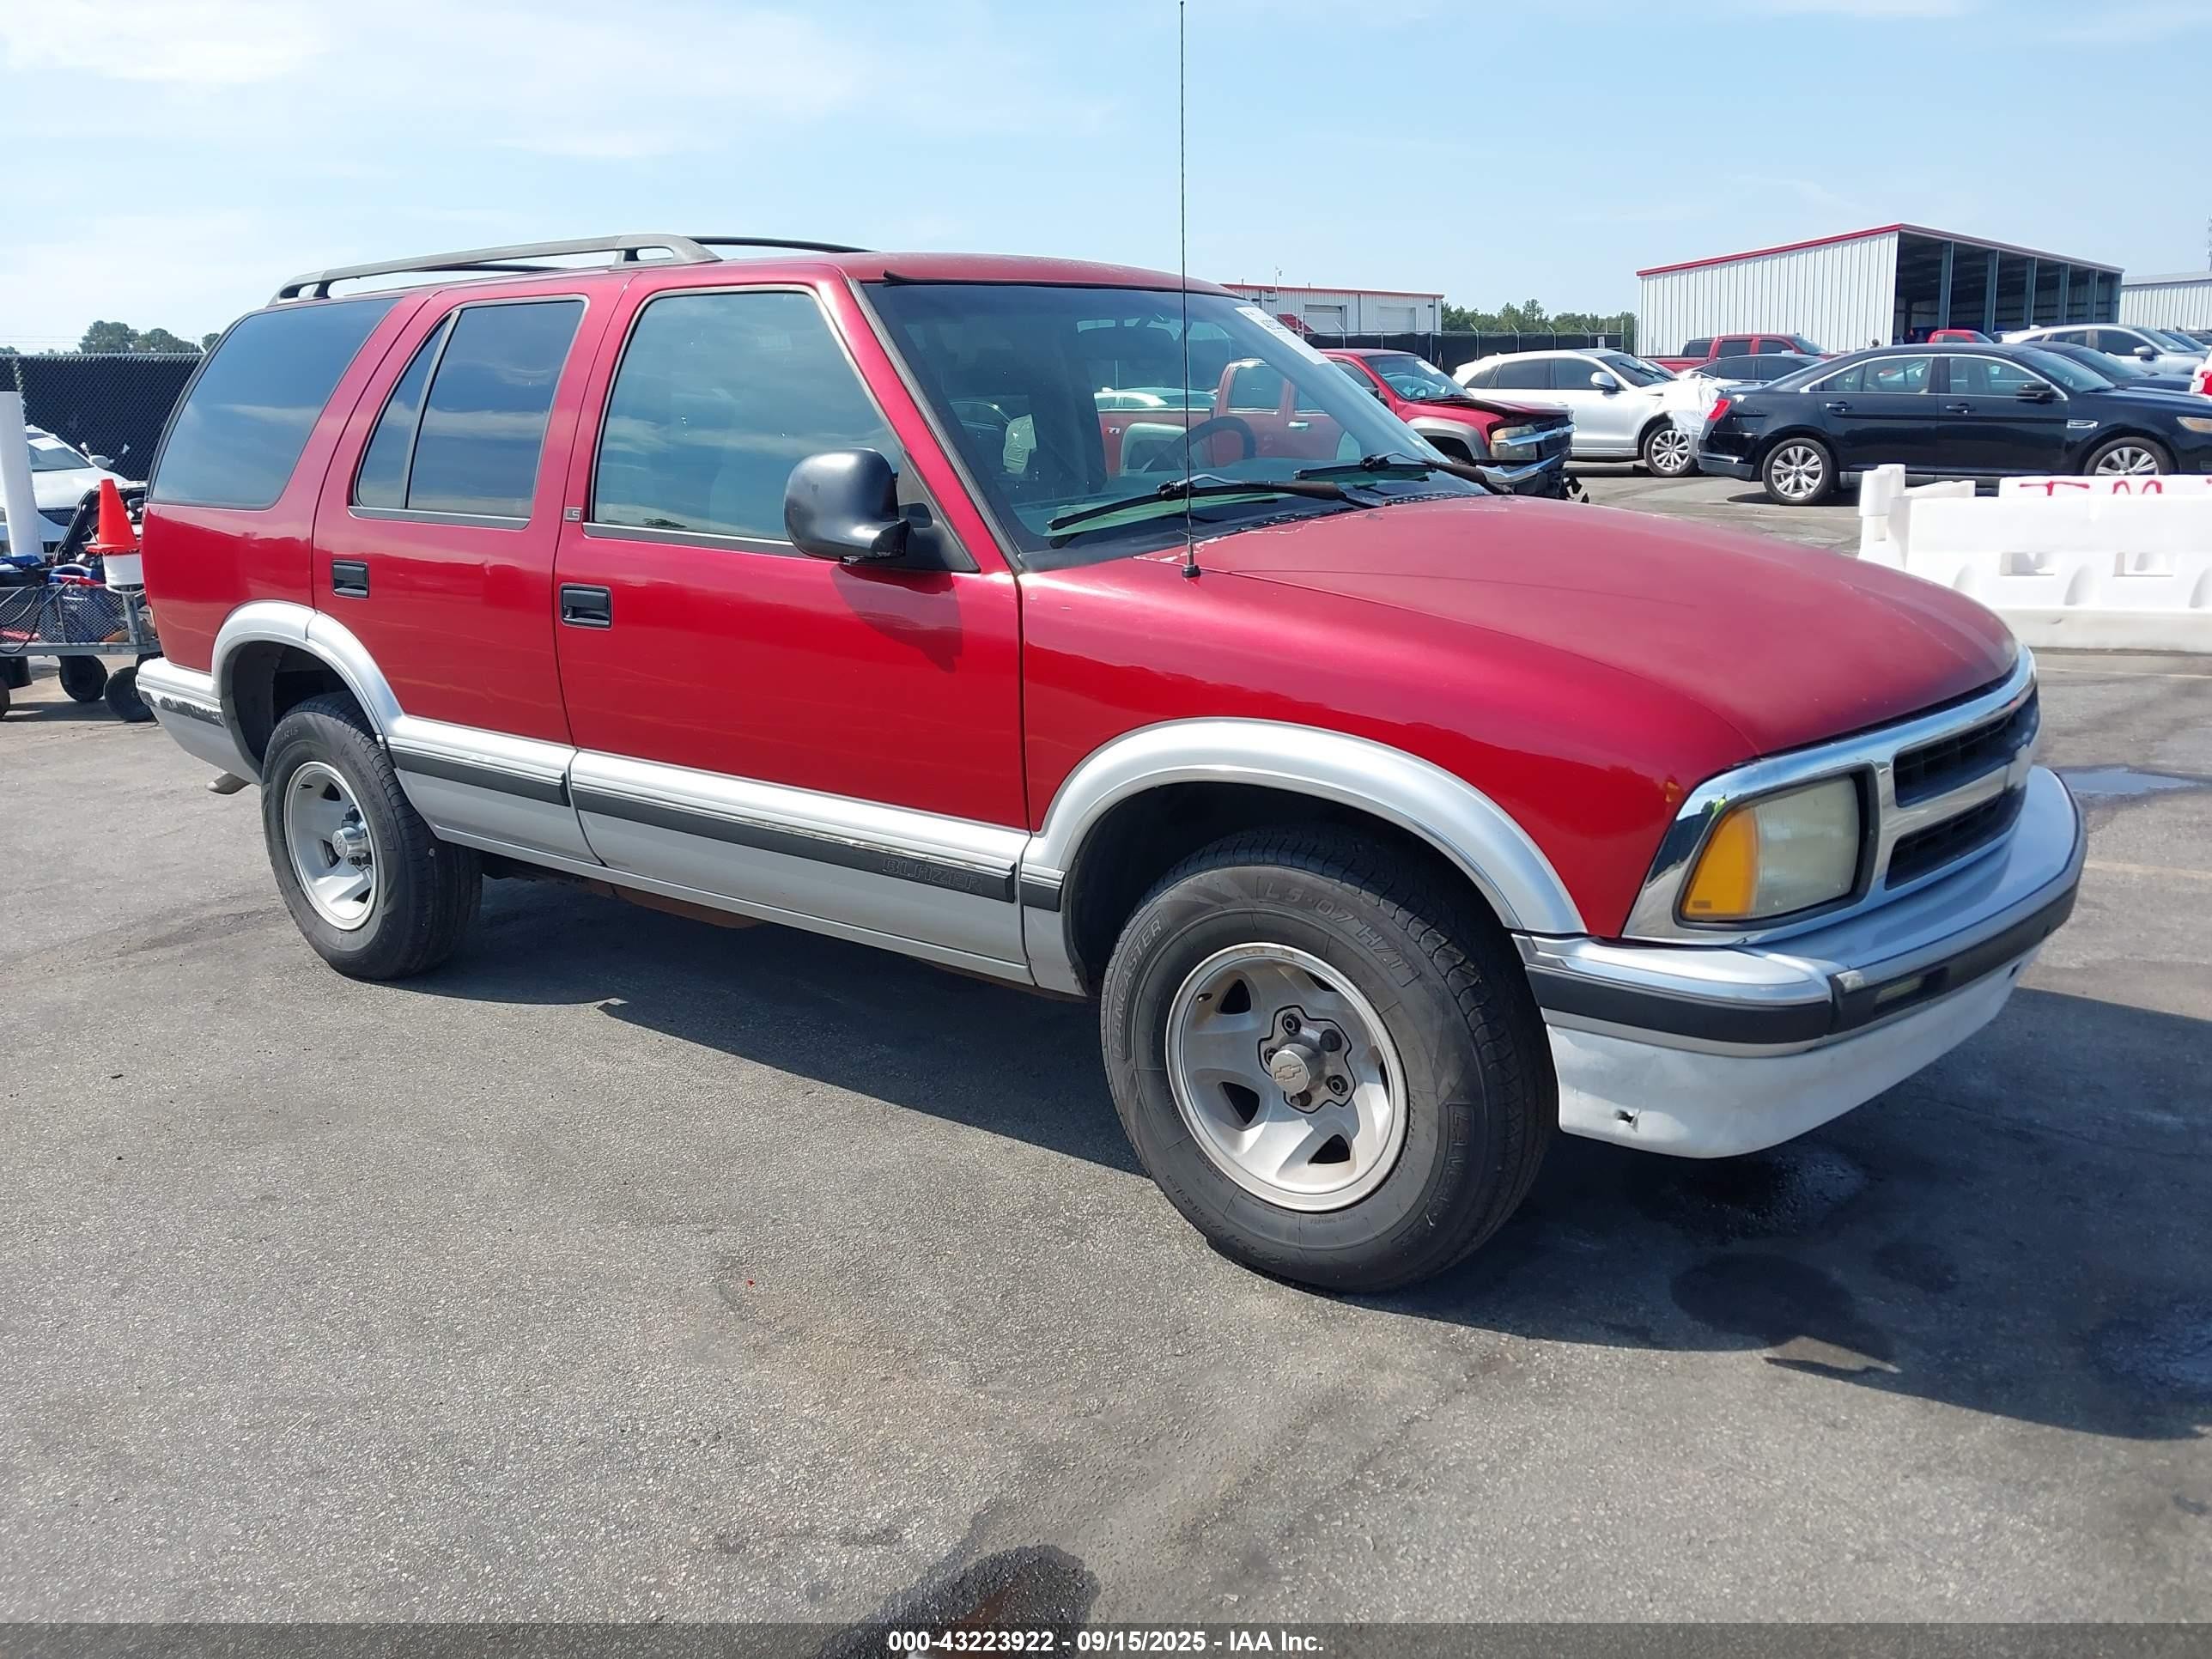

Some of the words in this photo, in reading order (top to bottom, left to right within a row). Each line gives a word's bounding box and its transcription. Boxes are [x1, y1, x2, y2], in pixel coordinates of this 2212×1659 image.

[565, 507, 581, 521] LS
[882, 857, 983, 893] BLAZER
[1112, 917, 1163, 1053] LANCASTER
